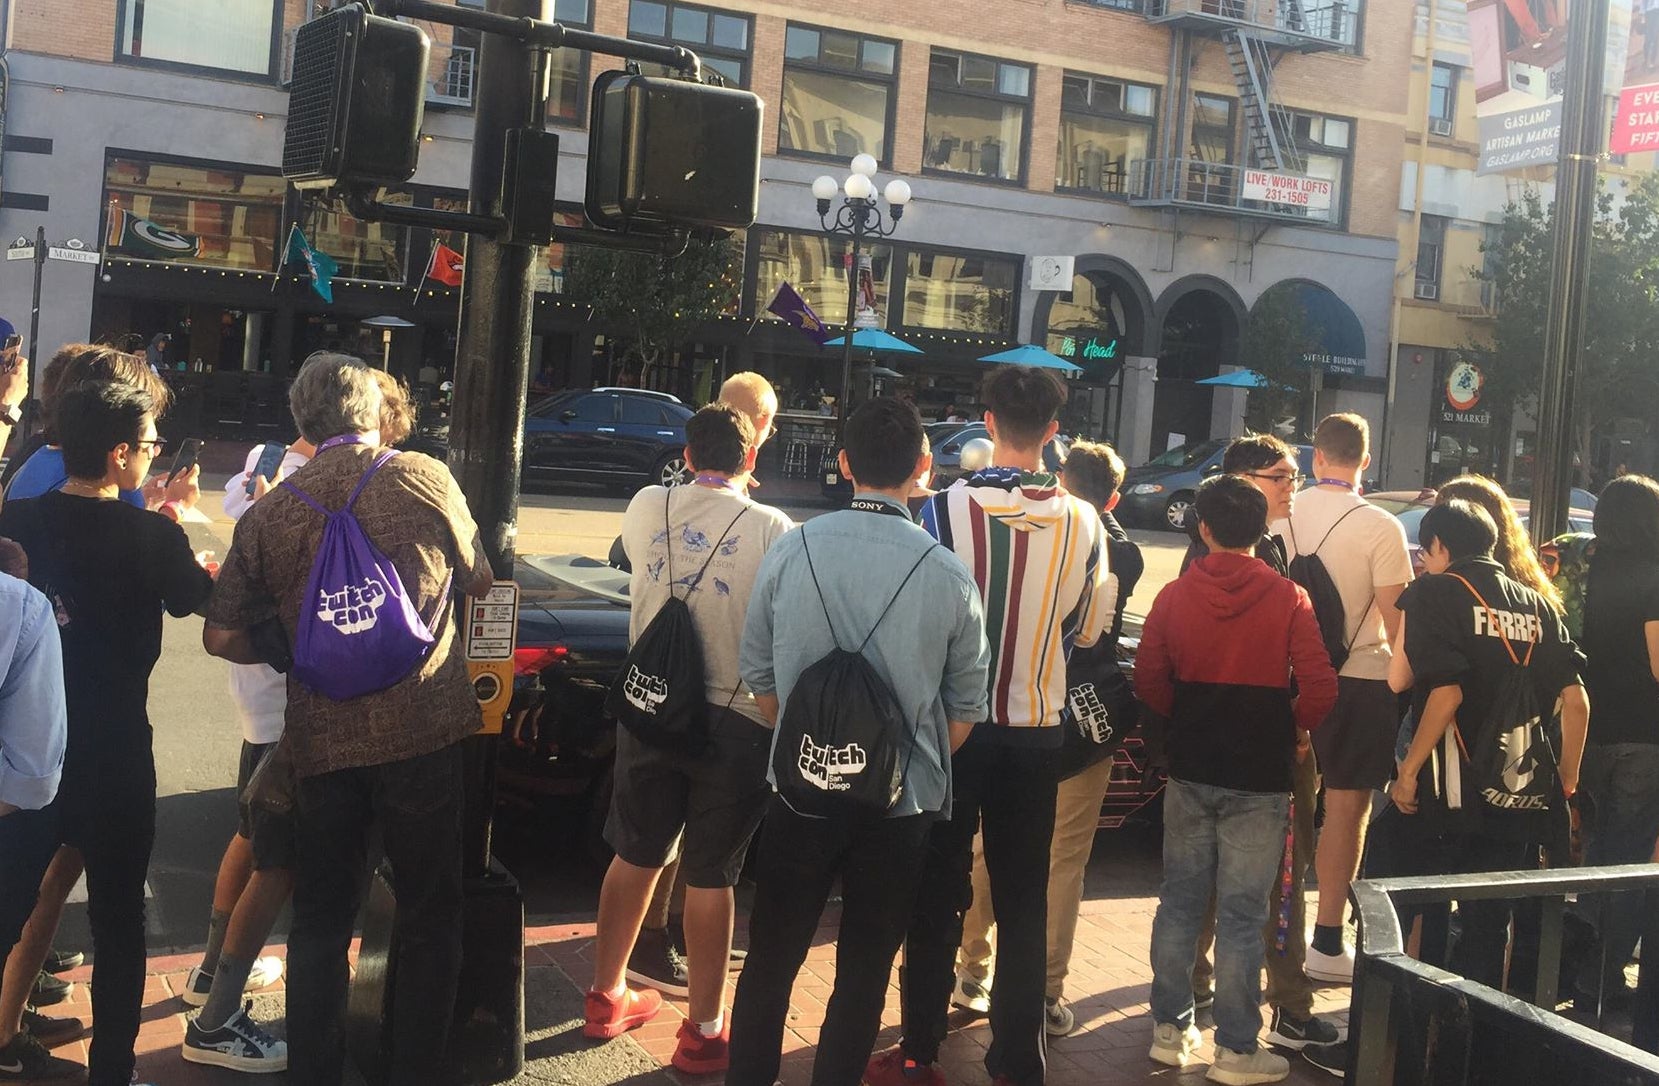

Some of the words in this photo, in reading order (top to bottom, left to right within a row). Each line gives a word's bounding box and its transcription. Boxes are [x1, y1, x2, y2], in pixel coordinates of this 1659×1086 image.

[1504, 109, 1552, 130] GASLAMP
[1486, 133, 1523, 151] ARTISAN
[1526, 125, 1561, 143] MARKE
[1486, 144, 1554, 168] GASLAMP.ORG
[1265, 188, 1309, 205] 231-1505
[1301, 180, 1329, 195] LOFTS
[54, 249, 87, 261] MARKET
[1083, 337, 1116, 360] Head
[1455, 413, 1490, 424] MARKET
[851, 501, 884, 511] SONY
[700, 559, 735, 570] SASON
[319, 577, 386, 614] twtch
[1473, 606, 1543, 643] FERRE
[800, 733, 866, 767] twitch
[798, 754, 829, 783] con
[828, 775, 843, 783] San
[828, 782, 851, 791] Diego
